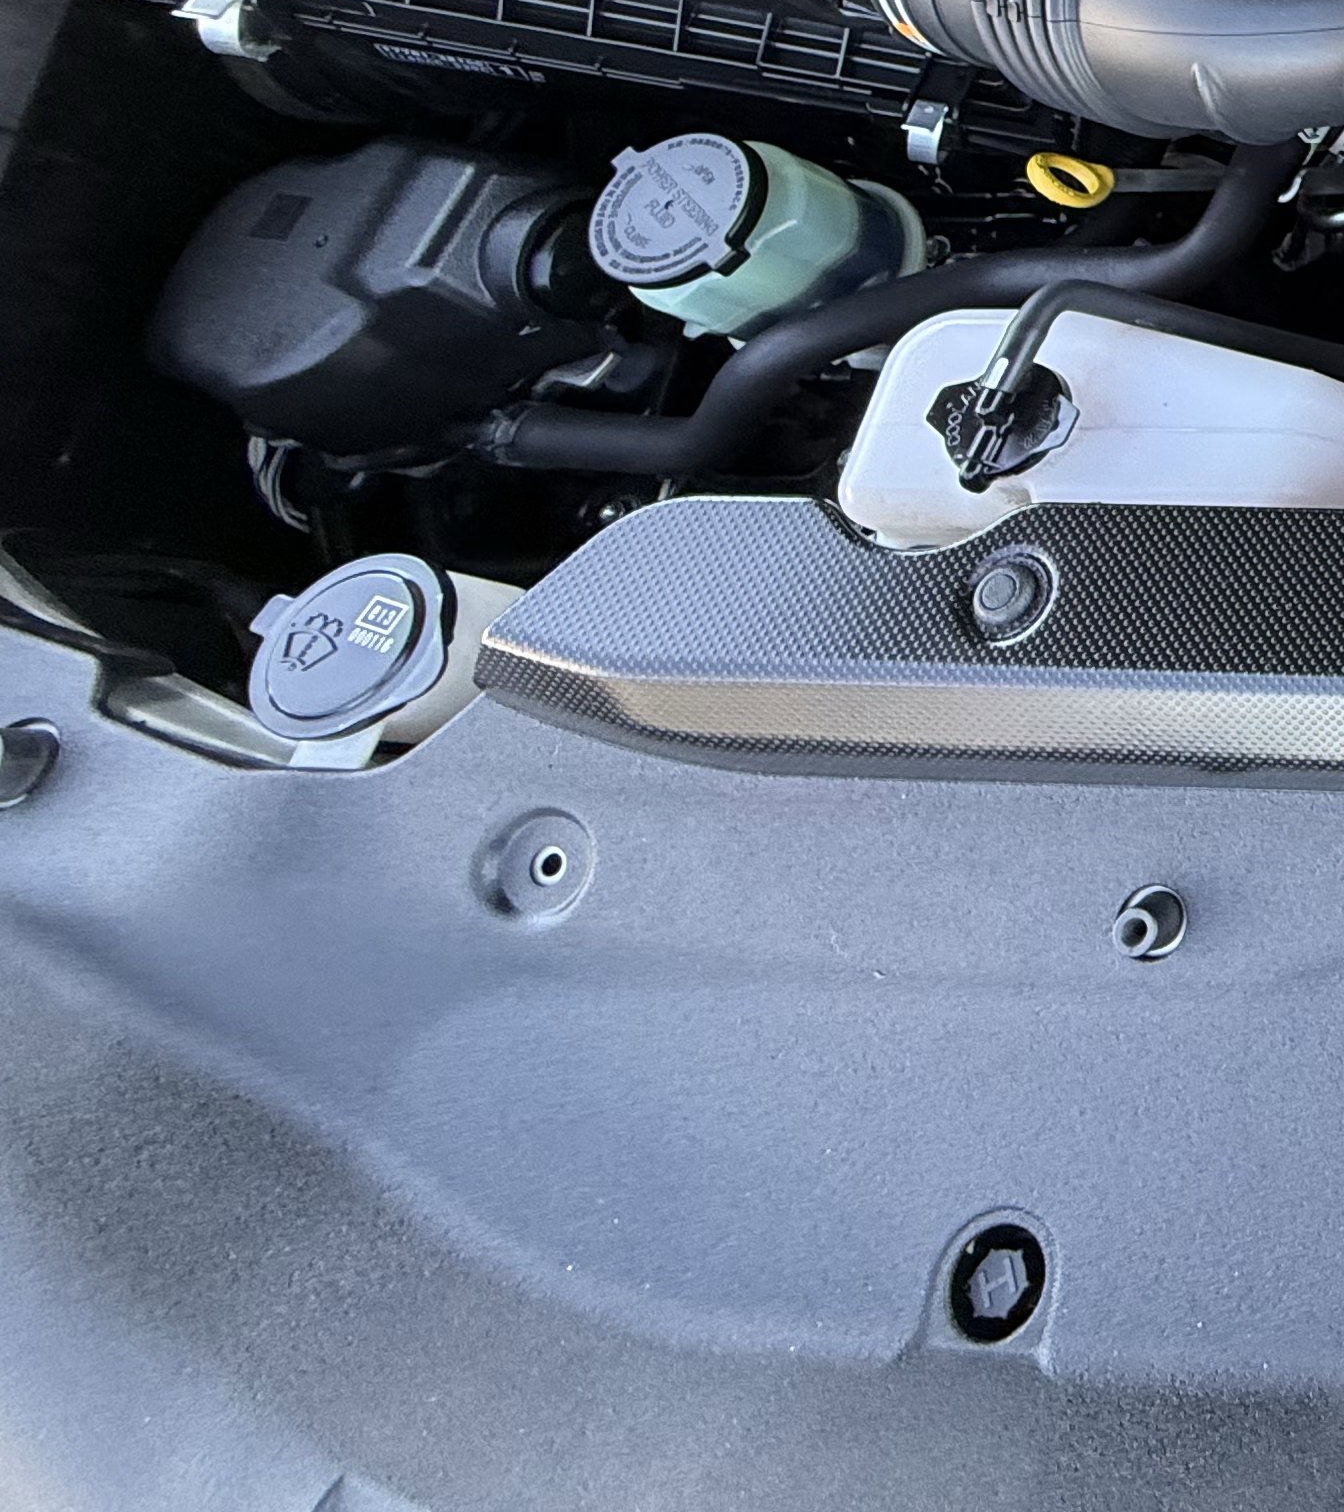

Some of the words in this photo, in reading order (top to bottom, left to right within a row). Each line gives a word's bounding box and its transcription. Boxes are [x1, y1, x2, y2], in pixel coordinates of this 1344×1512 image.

[642, 157, 679, 194] POWER
[671, 187, 720, 236] STEERING
[644, 198, 676, 229] FLUID
